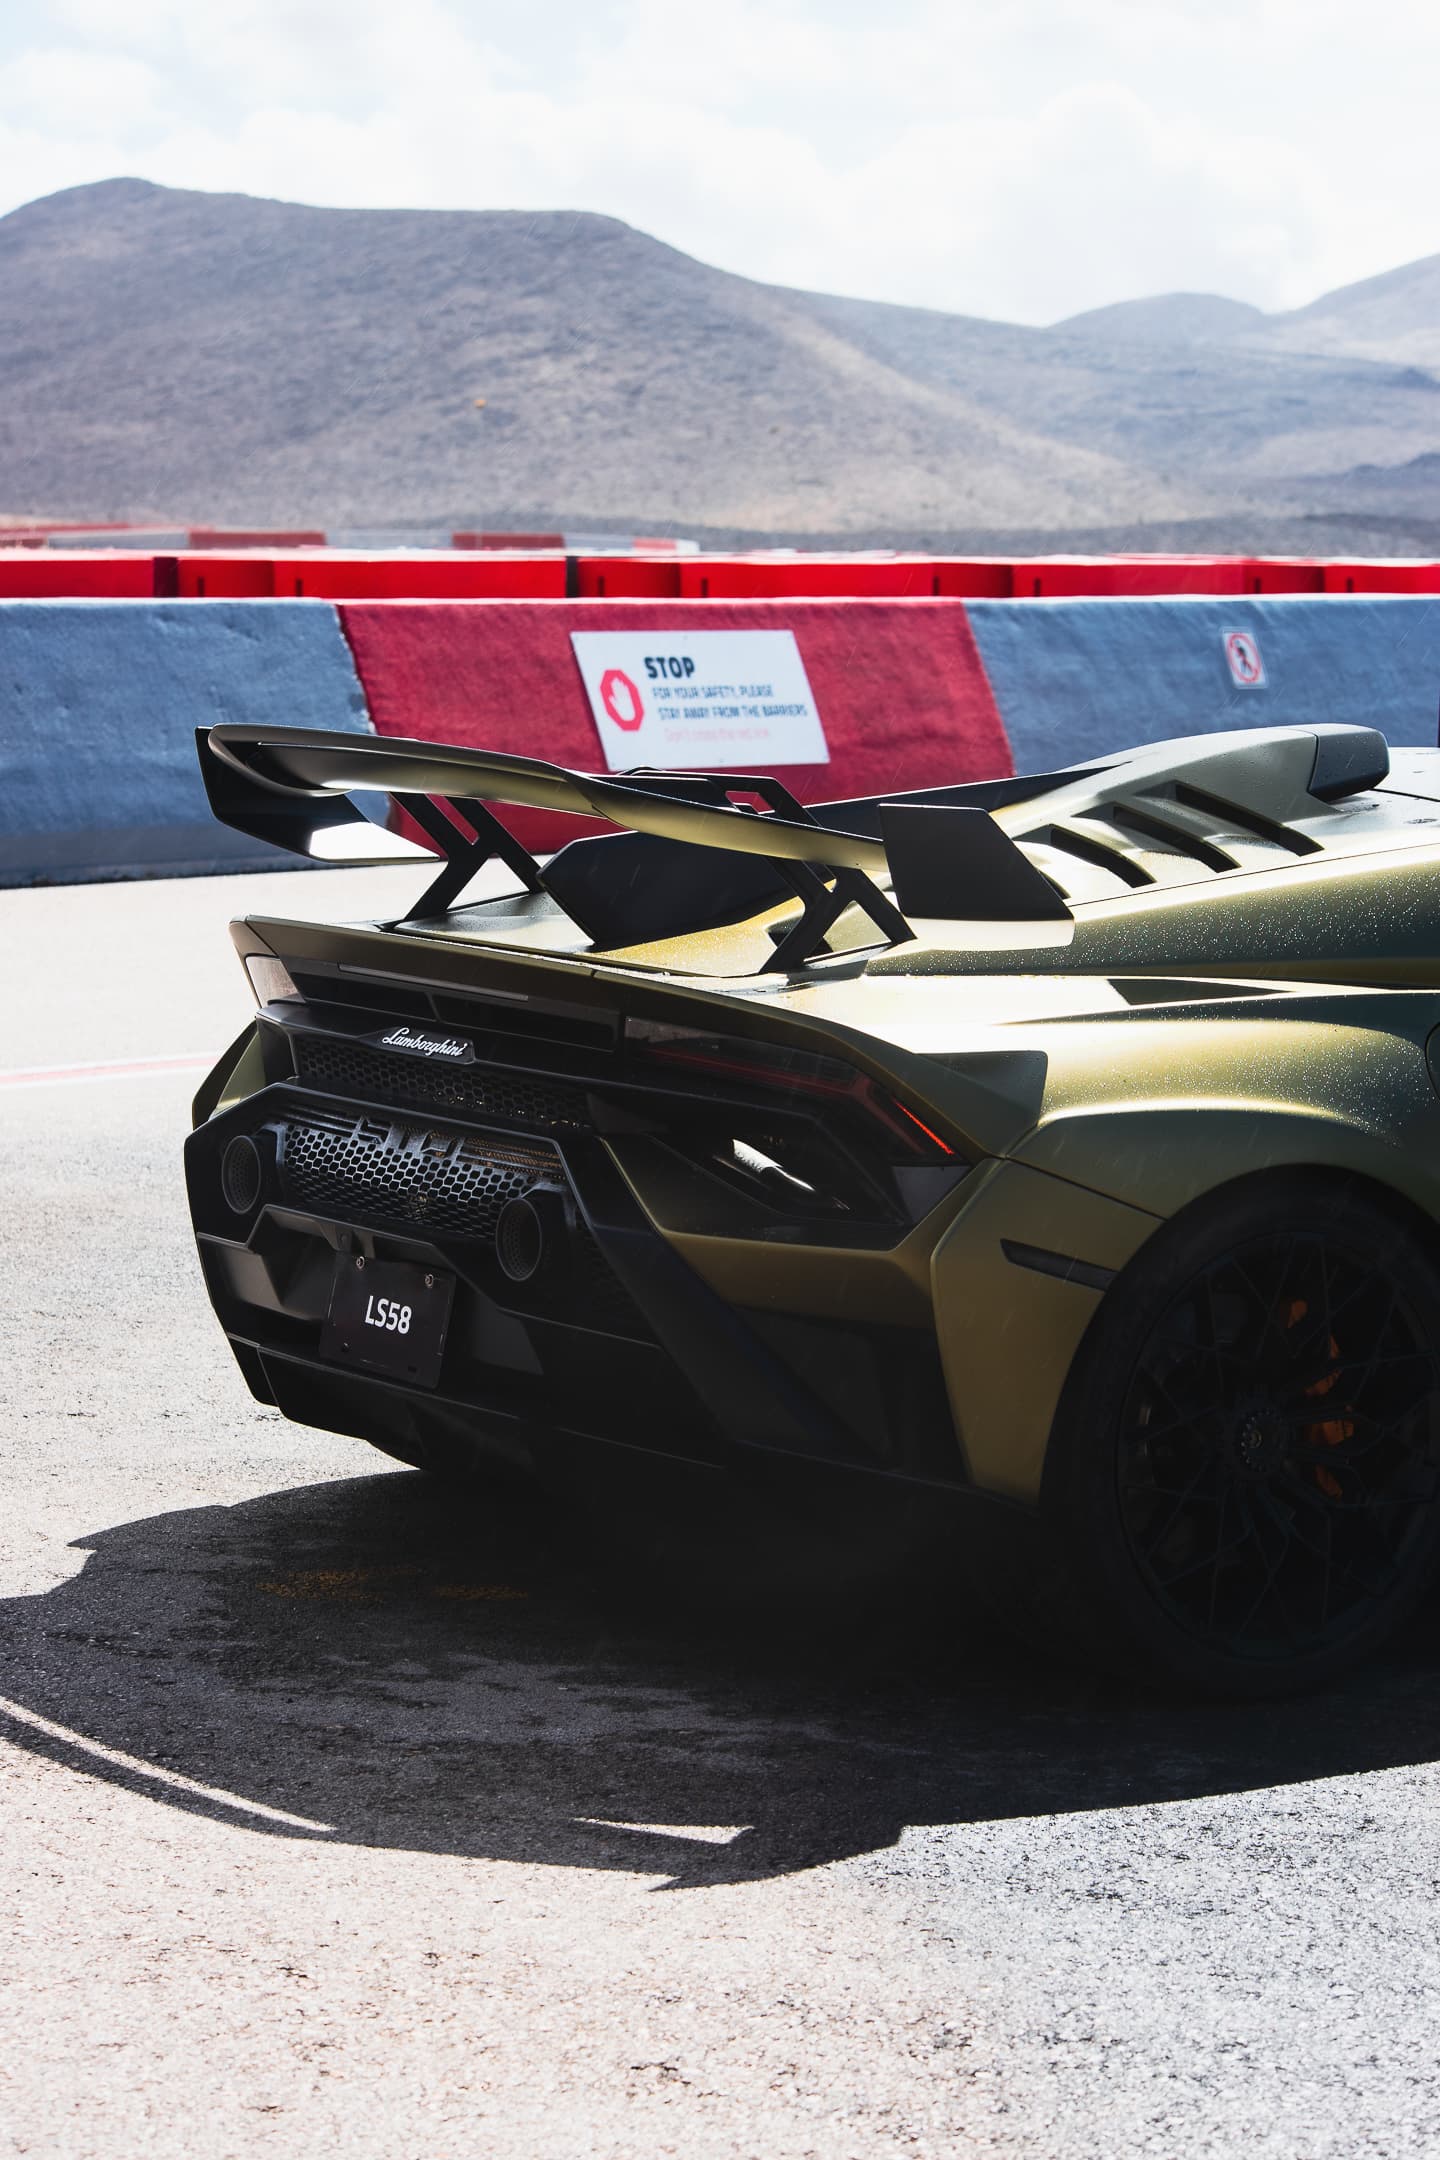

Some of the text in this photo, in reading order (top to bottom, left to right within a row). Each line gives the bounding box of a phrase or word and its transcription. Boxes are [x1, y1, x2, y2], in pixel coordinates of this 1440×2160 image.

[644, 656, 695, 679] STOP
[652, 685, 671, 699] FOR
[674, 685, 699, 699] YOUR
[739, 684, 773, 697] PLEASE
[658, 704, 808, 720] STAY AWAY FROM THE BARRIERS
[381, 1027, 467, 1056] Lamborghini
[365, 1295, 412, 1334] LS58
